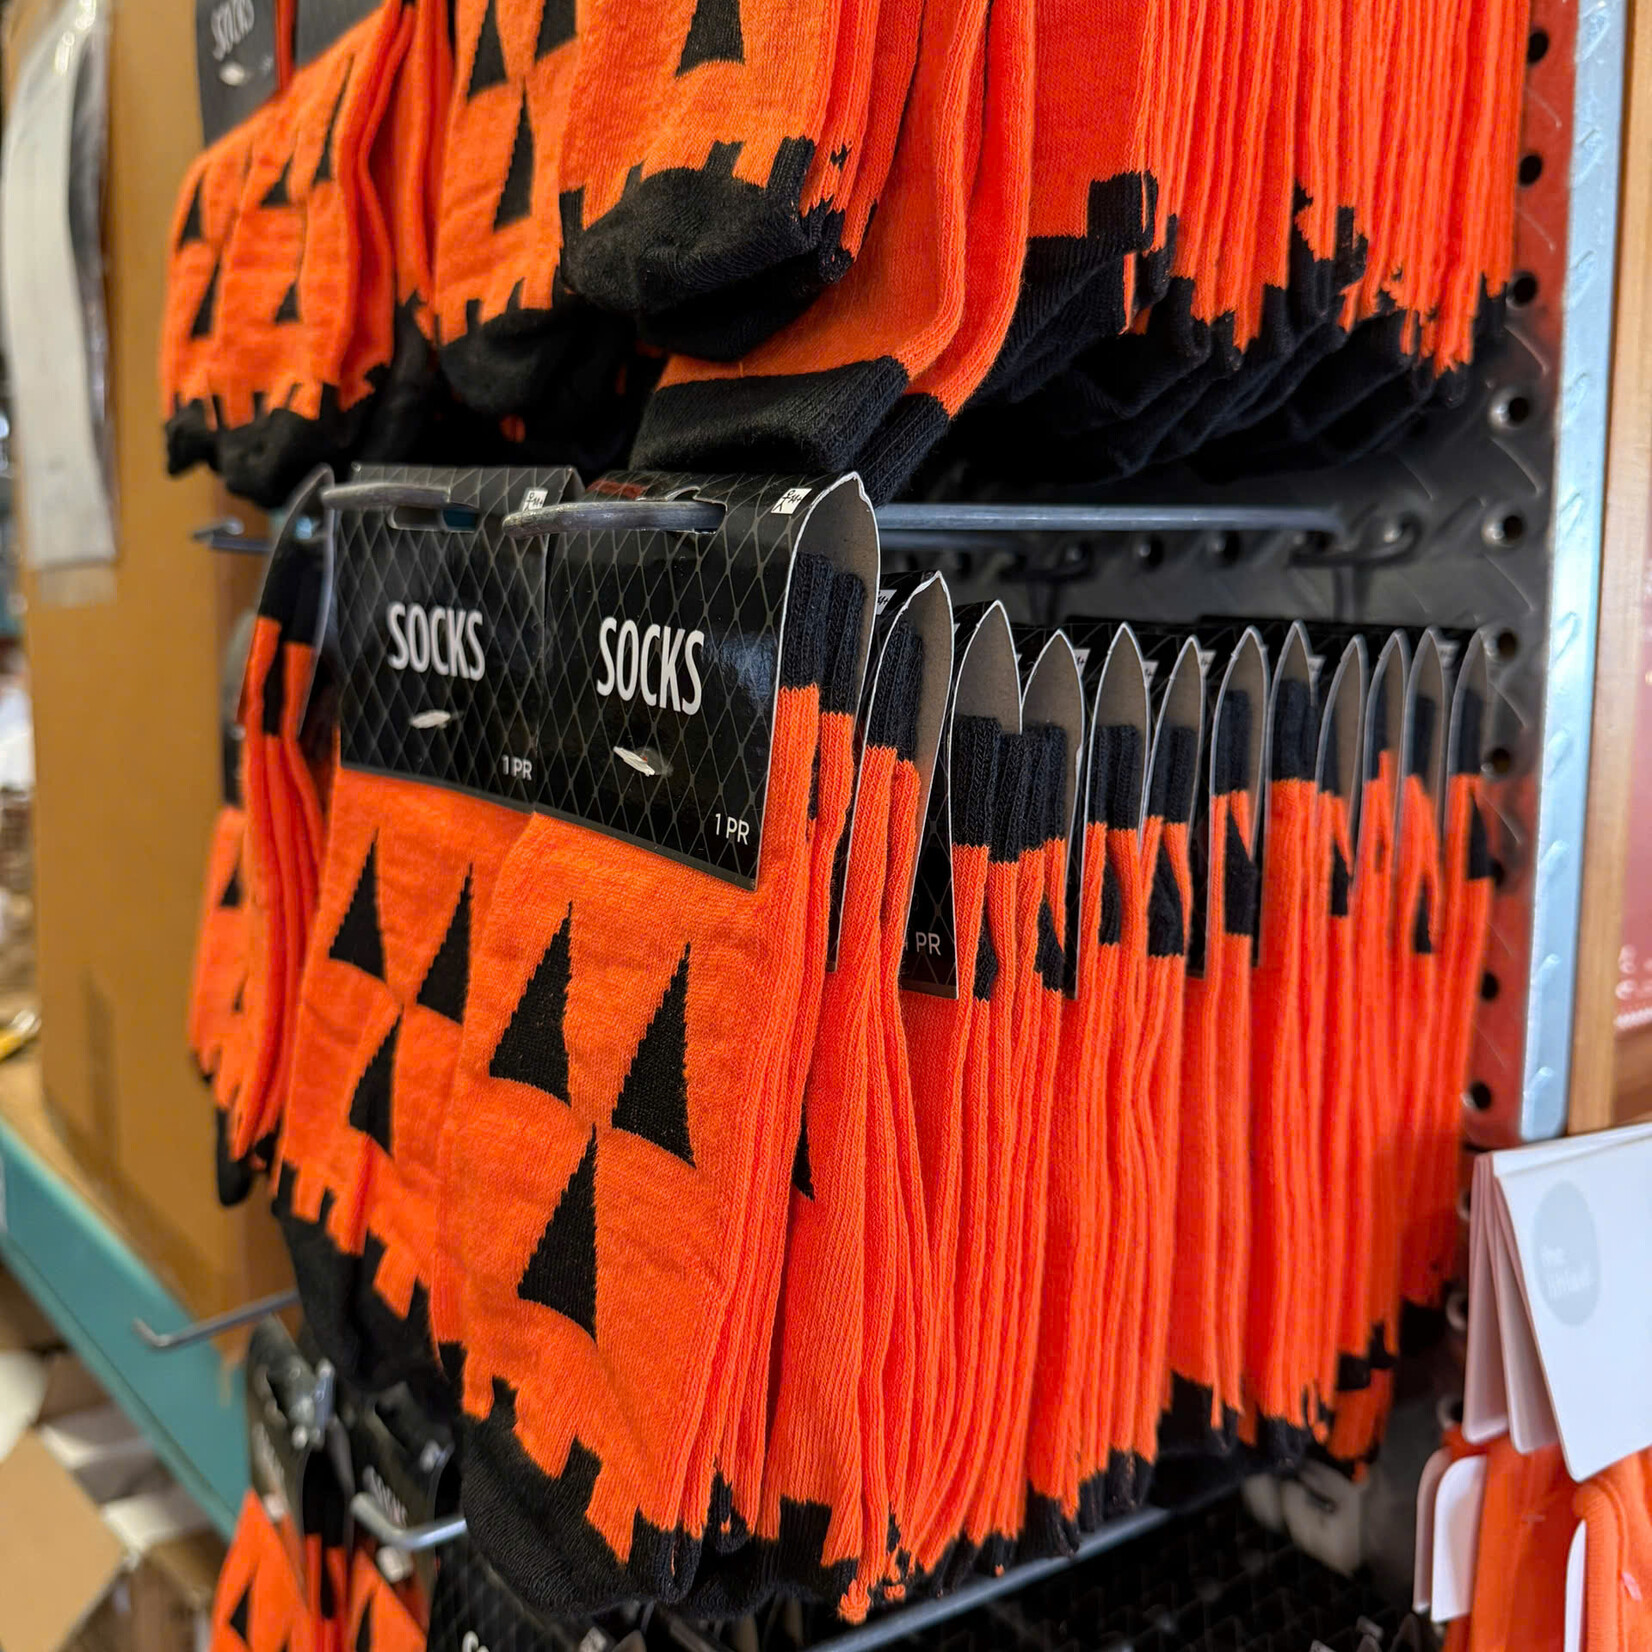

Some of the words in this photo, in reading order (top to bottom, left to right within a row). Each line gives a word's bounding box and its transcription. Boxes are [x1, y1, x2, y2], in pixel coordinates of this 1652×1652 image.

[387, 601, 486, 682] SOCKS
[596, 616, 705, 716] SOCKS
[501, 754, 510, 776] 1
[511, 756, 533, 781] PR
[715, 813, 722, 836] 1
[725, 816, 749, 846] PR
[915, 931, 942, 956] PR
